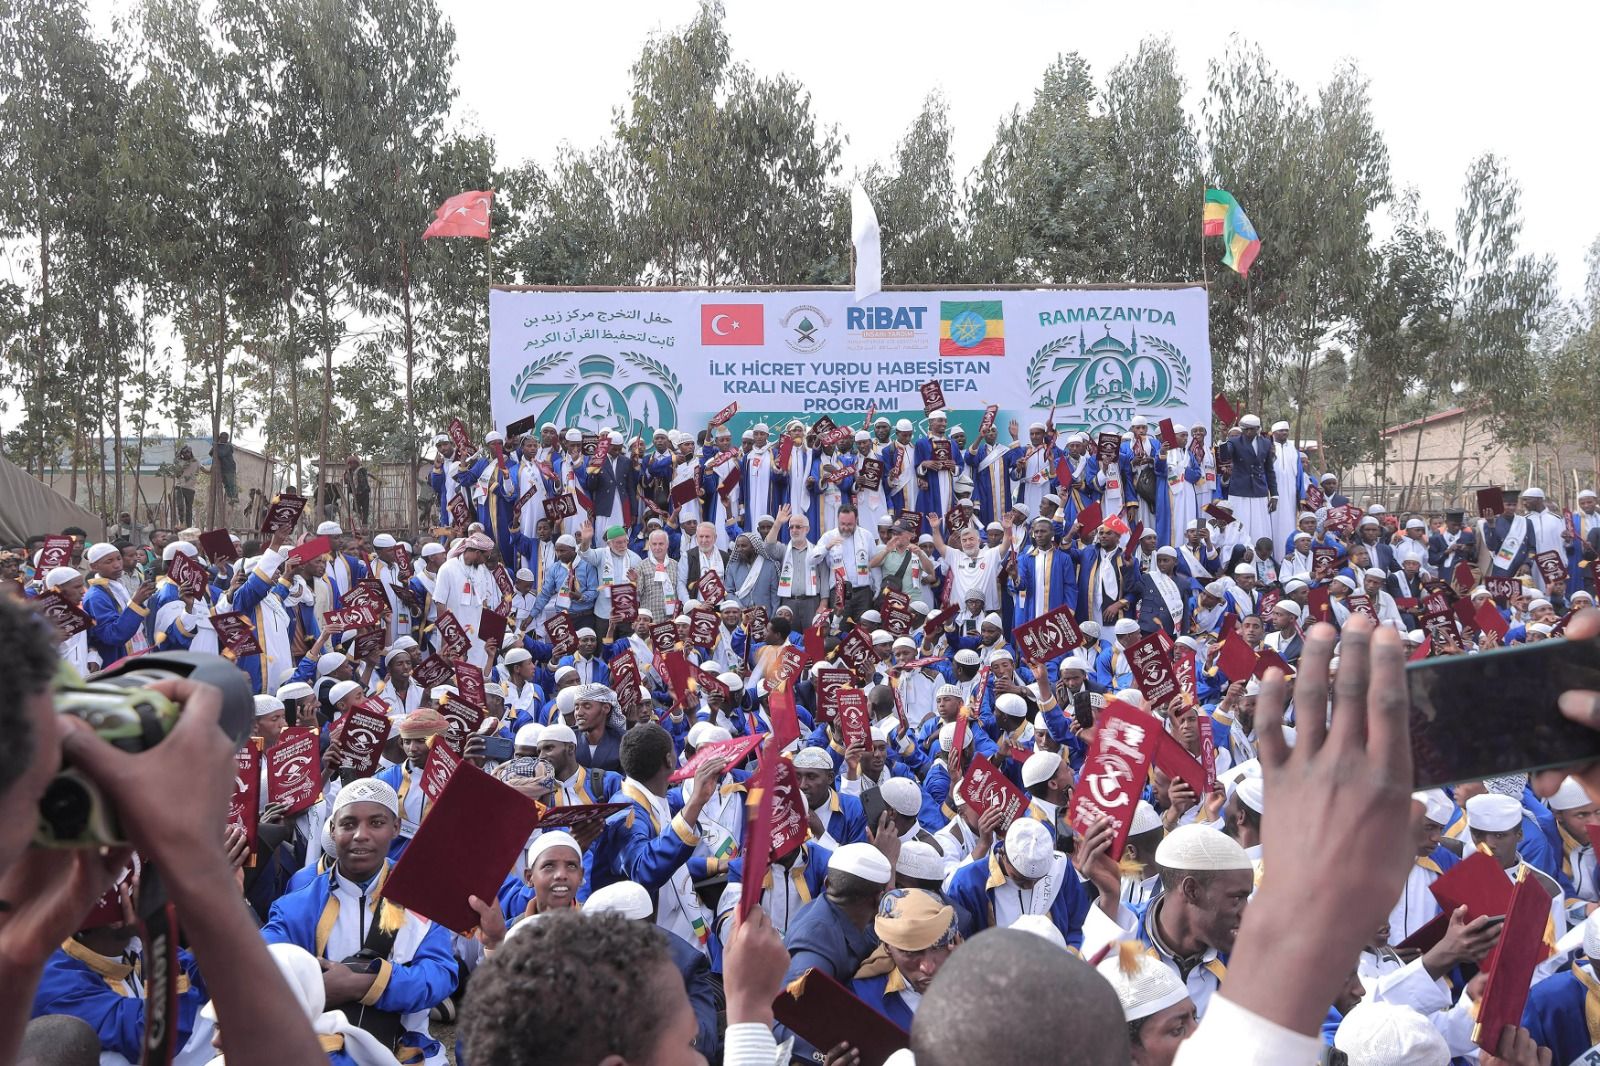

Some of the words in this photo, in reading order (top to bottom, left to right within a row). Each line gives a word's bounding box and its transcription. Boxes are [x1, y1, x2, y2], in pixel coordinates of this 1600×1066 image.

[523, 315, 539, 327] بن
[541, 311, 563, 325] زيد
[565, 308, 595, 322] مركز
[597, 309, 641, 323] التخرج
[643, 311, 673, 324] حفل
[523, 331, 561, 351] الكريم
[563, 328, 600, 343] القرآن
[601, 329, 647, 343] لتحفيظ
[647, 335, 675, 349] ثابت
[709, 360, 737, 376] İLK
[742, 360, 805, 376] HİCRET
[810, 361, 872, 376] YURDU
[877, 359, 990, 377] HABEŞİSTAN
[723, 380, 775, 394] KRALI
[781, 378, 869, 396] NECAŞİYE
[937, 379, 978, 392] EFA
[804, 397, 899, 411] PROGRAMI
